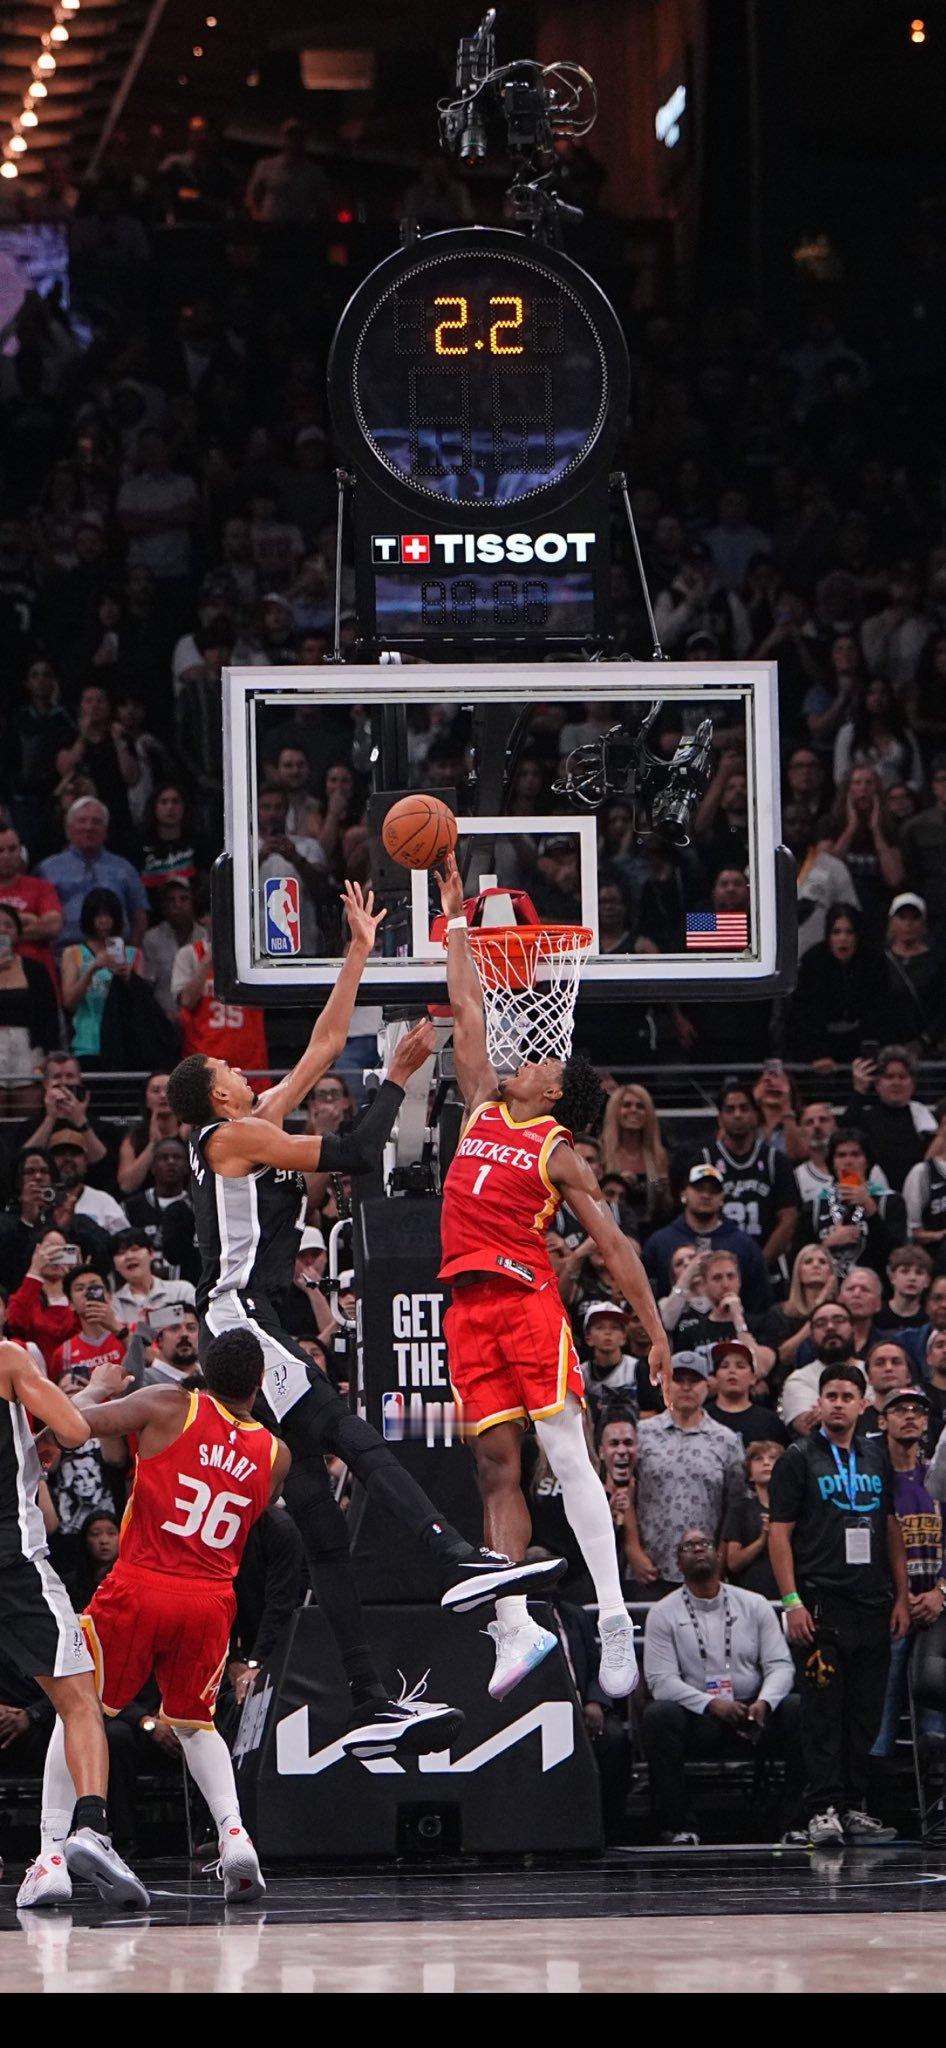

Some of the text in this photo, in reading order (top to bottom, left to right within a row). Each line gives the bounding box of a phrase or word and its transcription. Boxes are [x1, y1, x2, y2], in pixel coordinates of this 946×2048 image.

[434, 296, 523, 355] 2.2
[435, 533, 596, 563] TISSOT
[271, 938, 288, 950] NBA
[208, 1001, 243, 1029] 35
[460, 1138, 538, 1171] ROCKETS
[472, 1164, 492, 1195] 1
[392, 1293, 444, 1338] GET
[392, 1342, 447, 1386] THE
[199, 1444, 257, 1482] SMART
[818, 1470, 882, 1500] prme
[160, 1472, 252, 1549] 36
